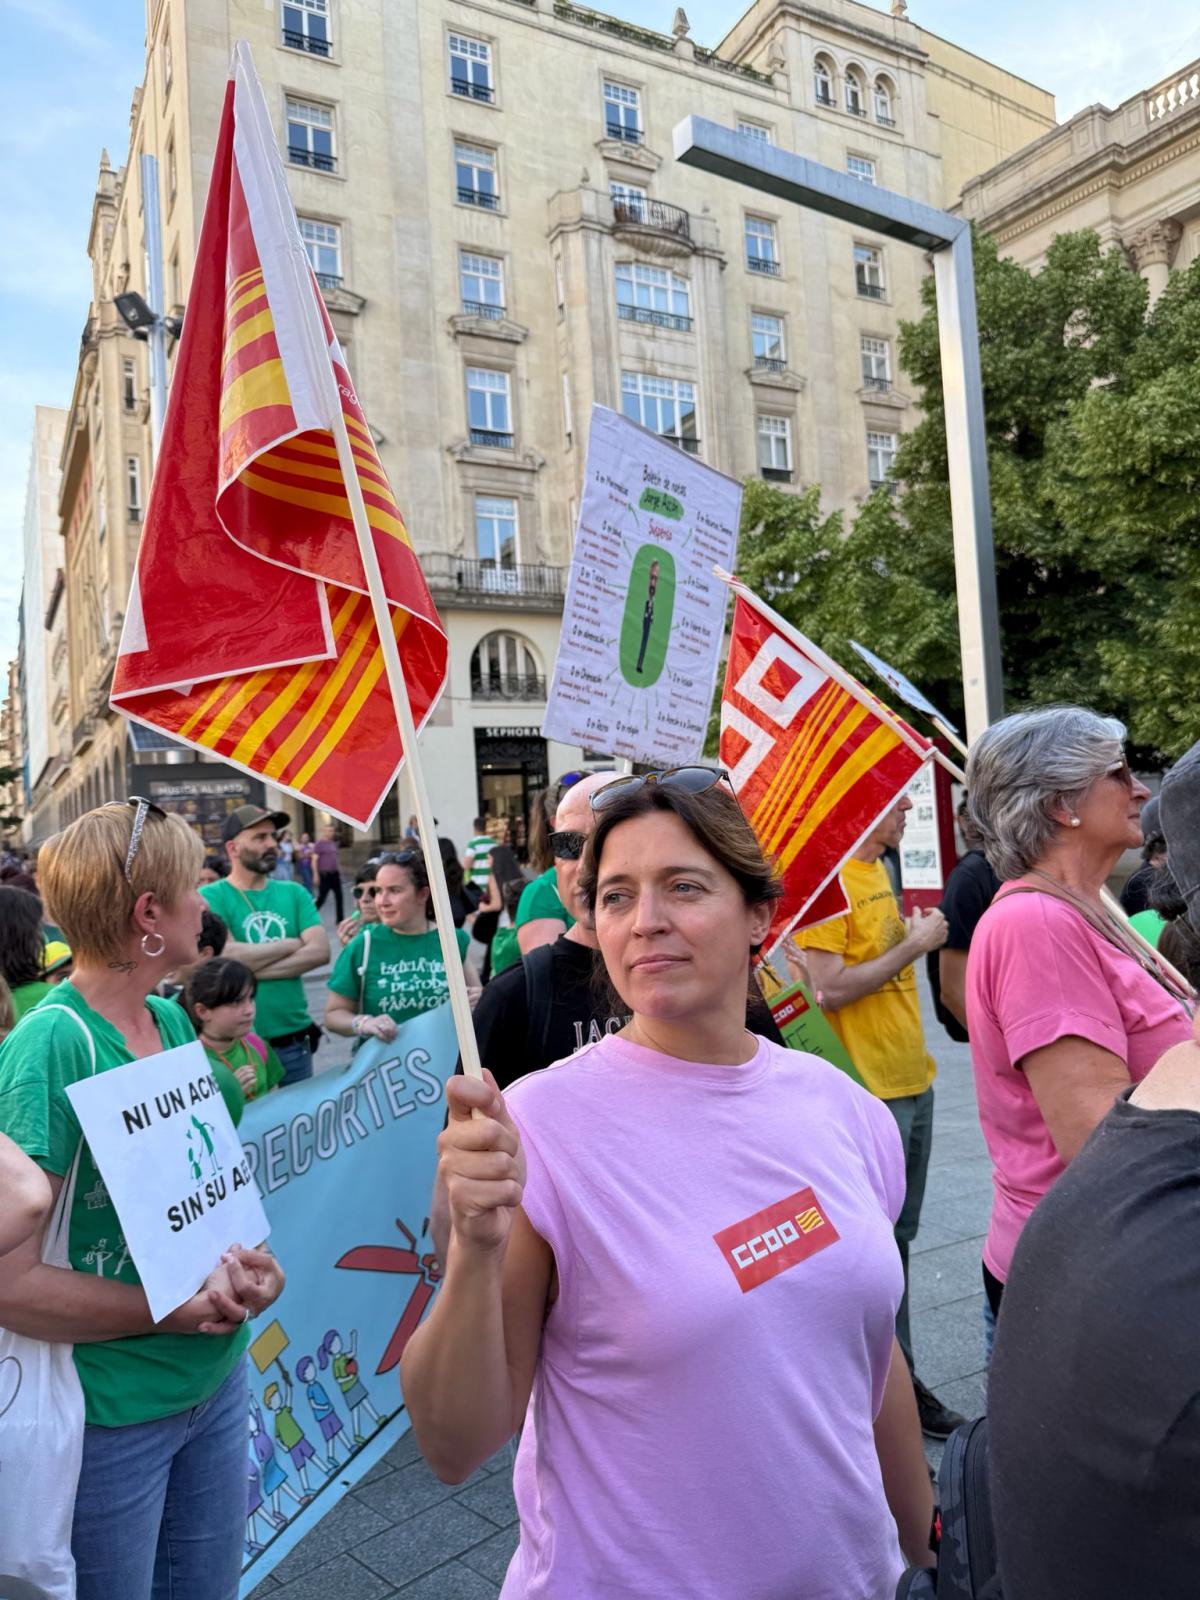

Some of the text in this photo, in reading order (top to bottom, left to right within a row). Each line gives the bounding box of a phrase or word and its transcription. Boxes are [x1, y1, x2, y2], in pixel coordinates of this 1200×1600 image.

[486, 728, 539, 737] SEPHORA
[121, 1102, 152, 1136] NI
[154, 1087, 186, 1119] UN
[167, 1191, 204, 1233] SIN
[204, 1175, 226, 1208] SU
[731, 1220, 800, 1269] CCOO
